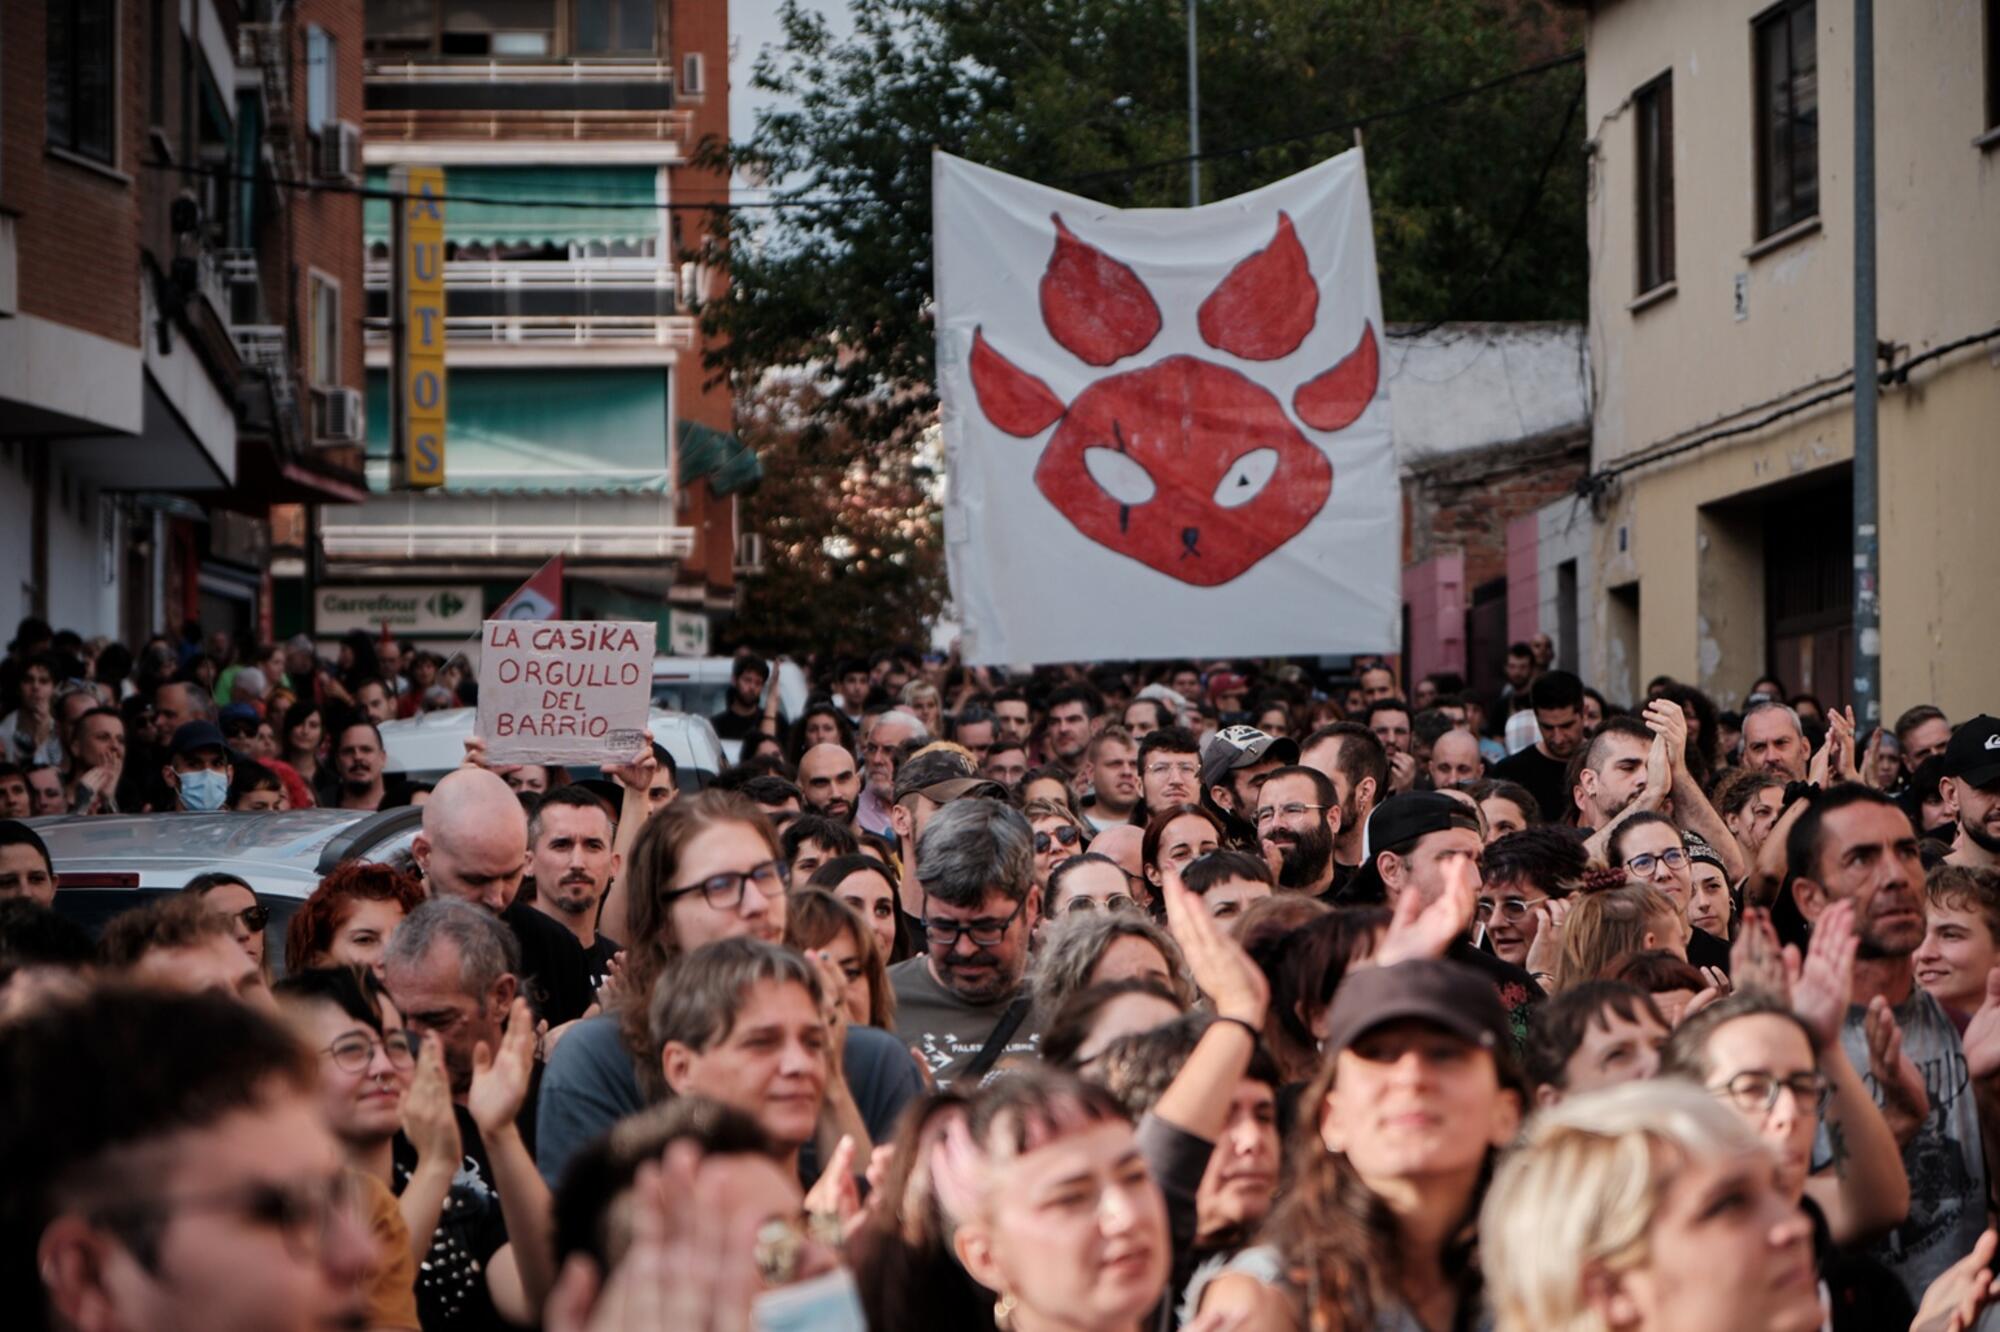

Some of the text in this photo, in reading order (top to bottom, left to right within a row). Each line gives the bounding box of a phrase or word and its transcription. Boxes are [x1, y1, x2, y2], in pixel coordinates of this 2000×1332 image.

[411, 180, 441, 474] AUTOS
[323, 593, 417, 612] Carrefour
[490, 626, 520, 649] LA
[499, 658, 640, 687] ORGULLO
[542, 690, 586, 710] DEL
